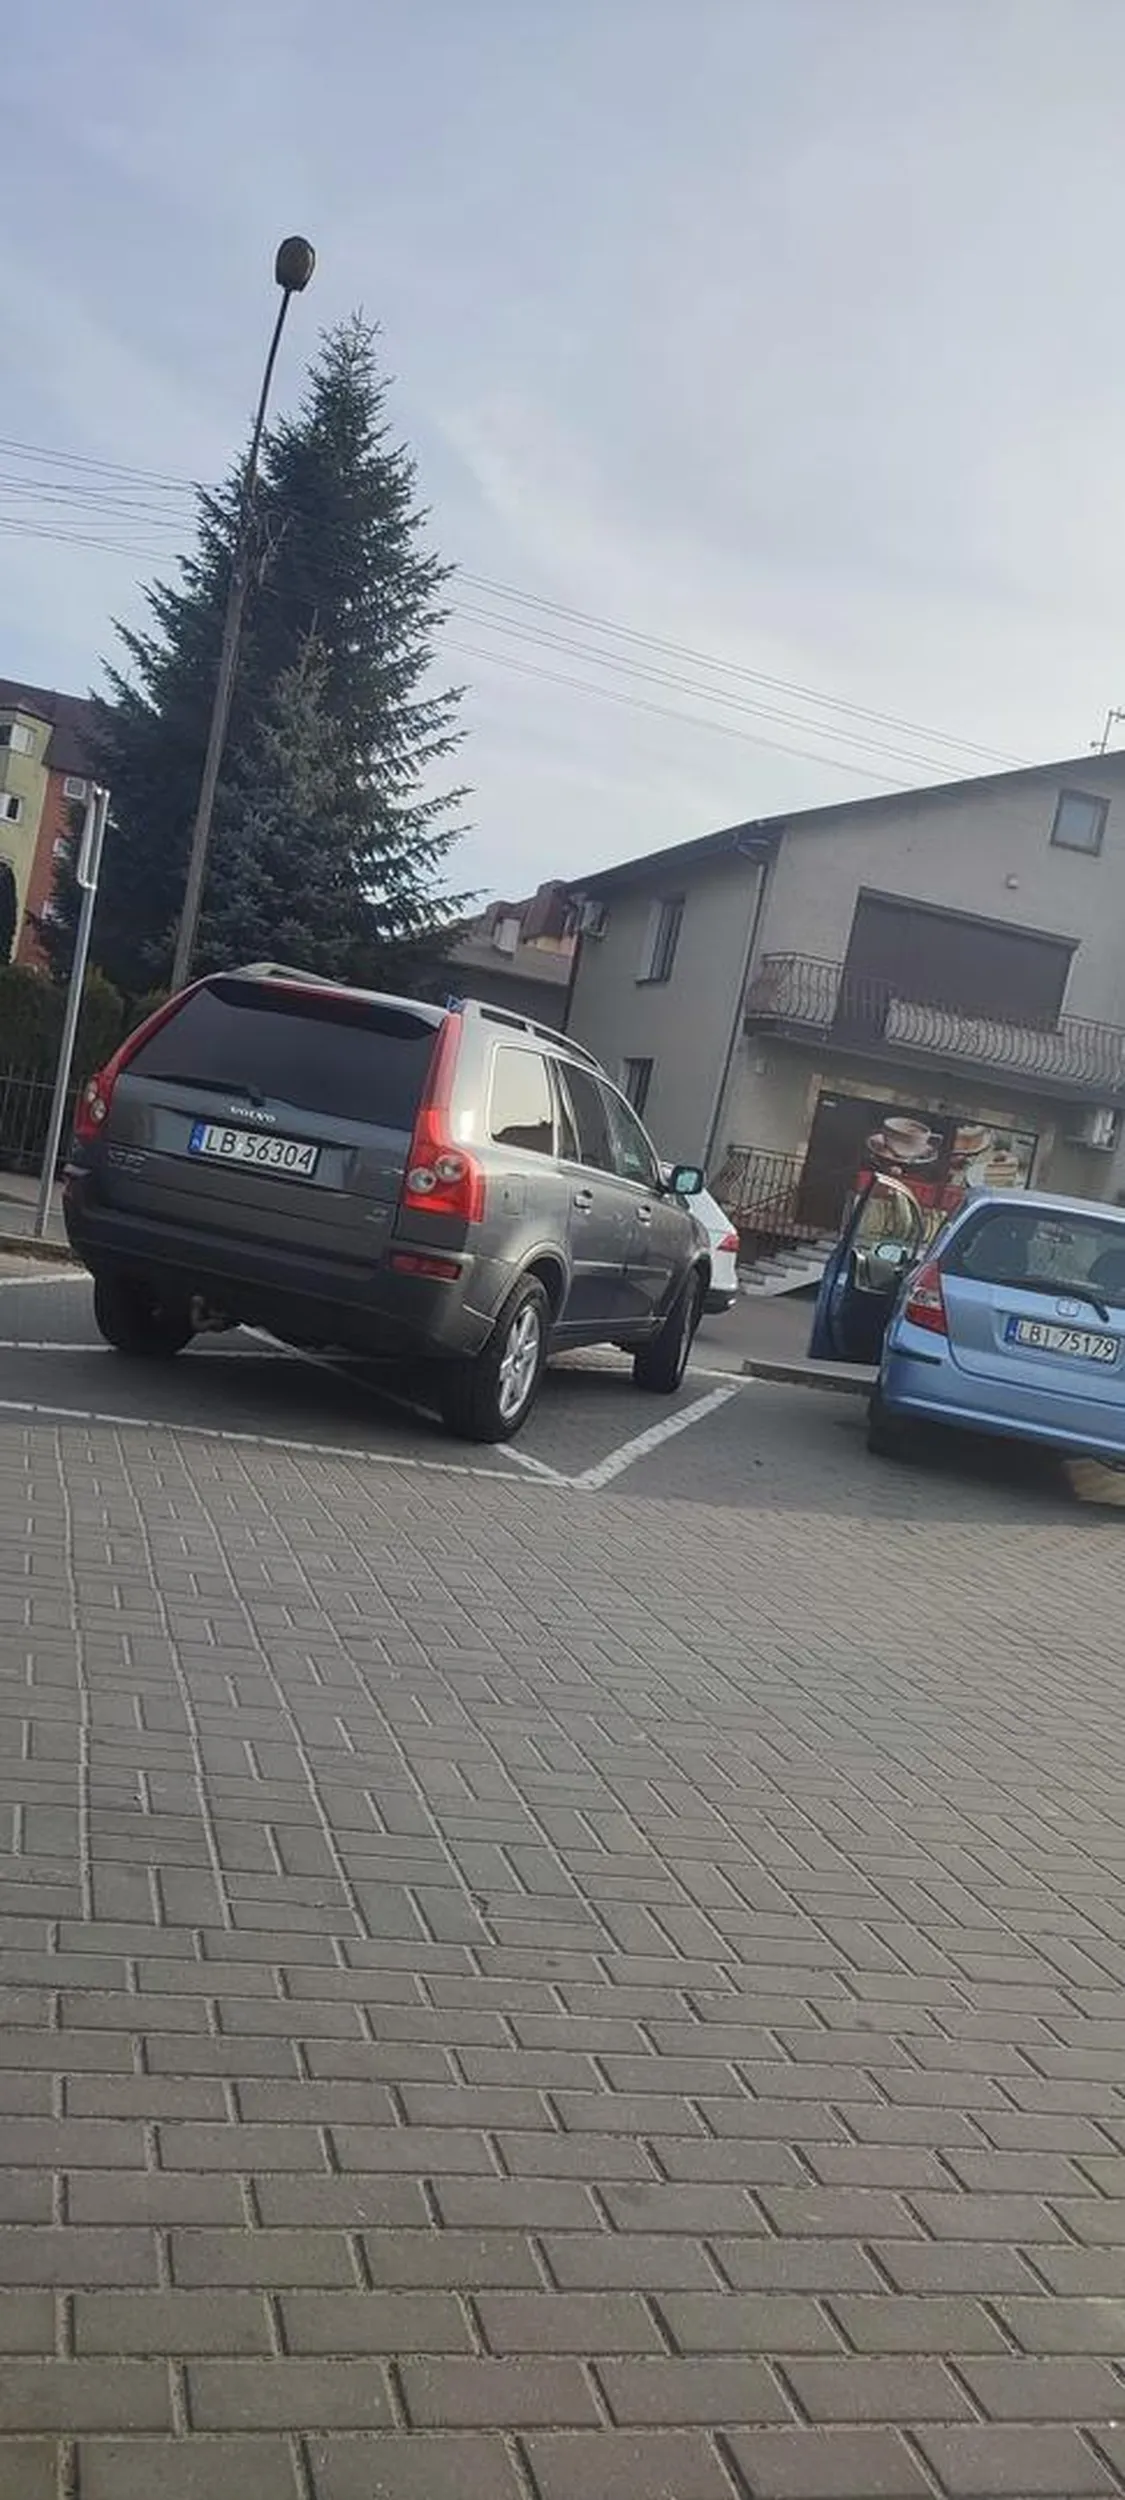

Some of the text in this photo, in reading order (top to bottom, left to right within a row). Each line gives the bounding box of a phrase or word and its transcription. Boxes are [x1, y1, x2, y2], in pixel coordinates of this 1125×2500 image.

[230, 1106, 276, 1123] VOLVO
[205, 1129, 314, 1172] LB 56304
[1058, 1331, 1115, 1357] 75179
